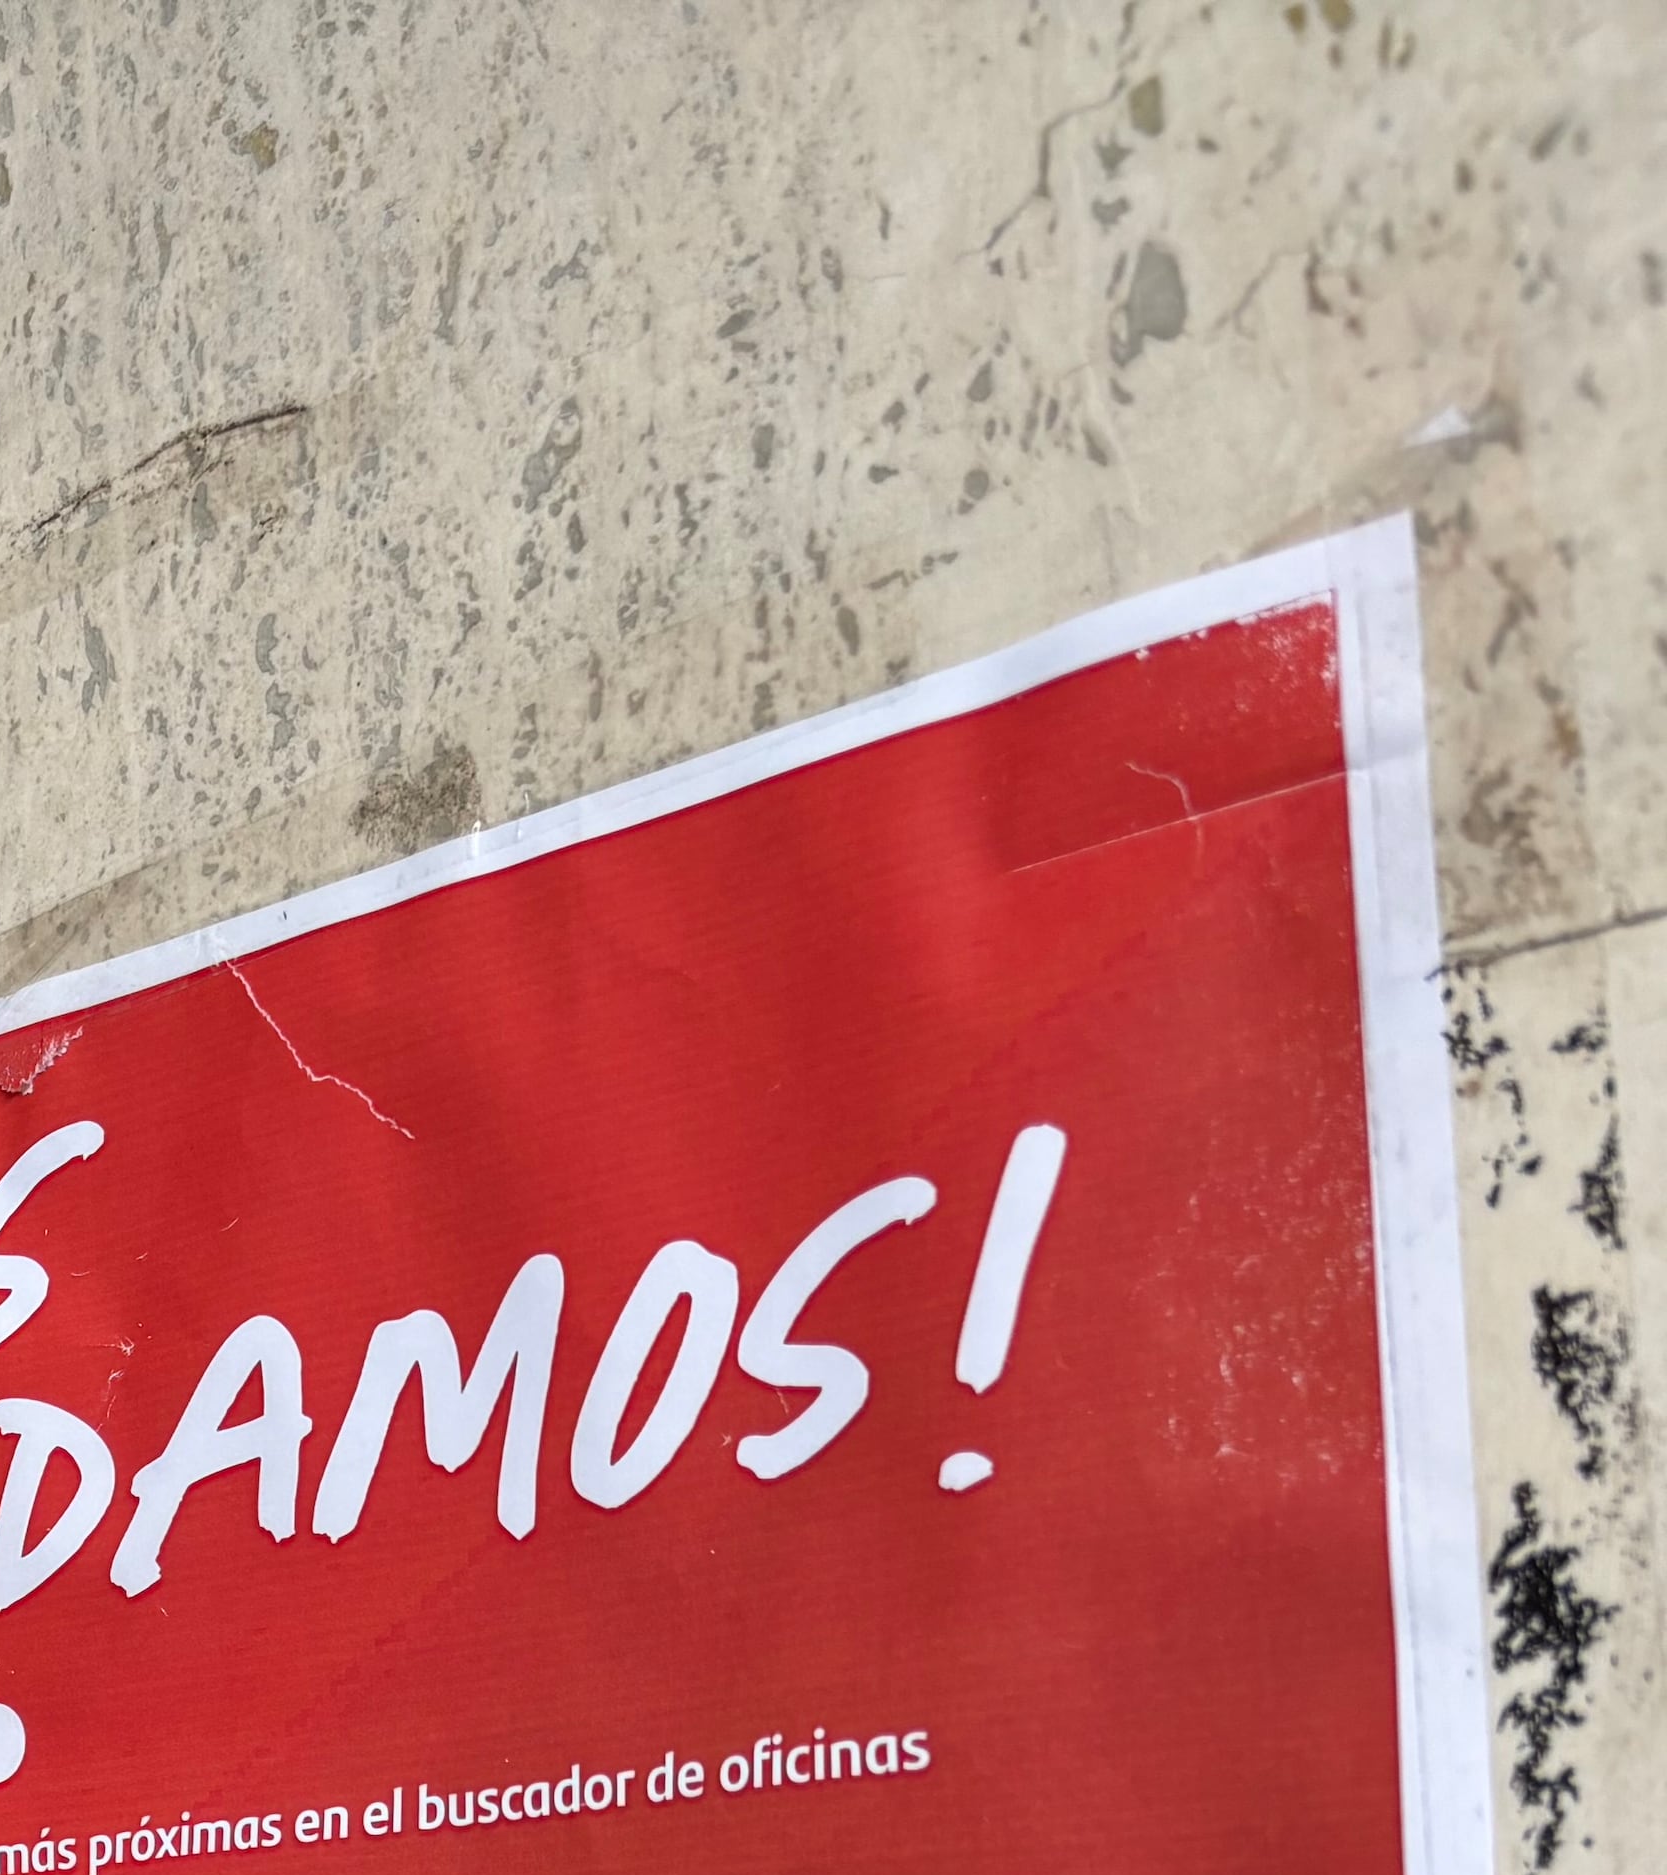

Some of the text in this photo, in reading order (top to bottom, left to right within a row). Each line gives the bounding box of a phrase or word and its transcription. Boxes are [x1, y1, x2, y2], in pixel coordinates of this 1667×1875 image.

[294, 1806, 349, 1843] en
[362, 1786, 403, 1836] el
[418, 1763, 636, 1830] buscador
[646, 1750, 705, 1803] de
[719, 1727, 931, 1792] oficinas
